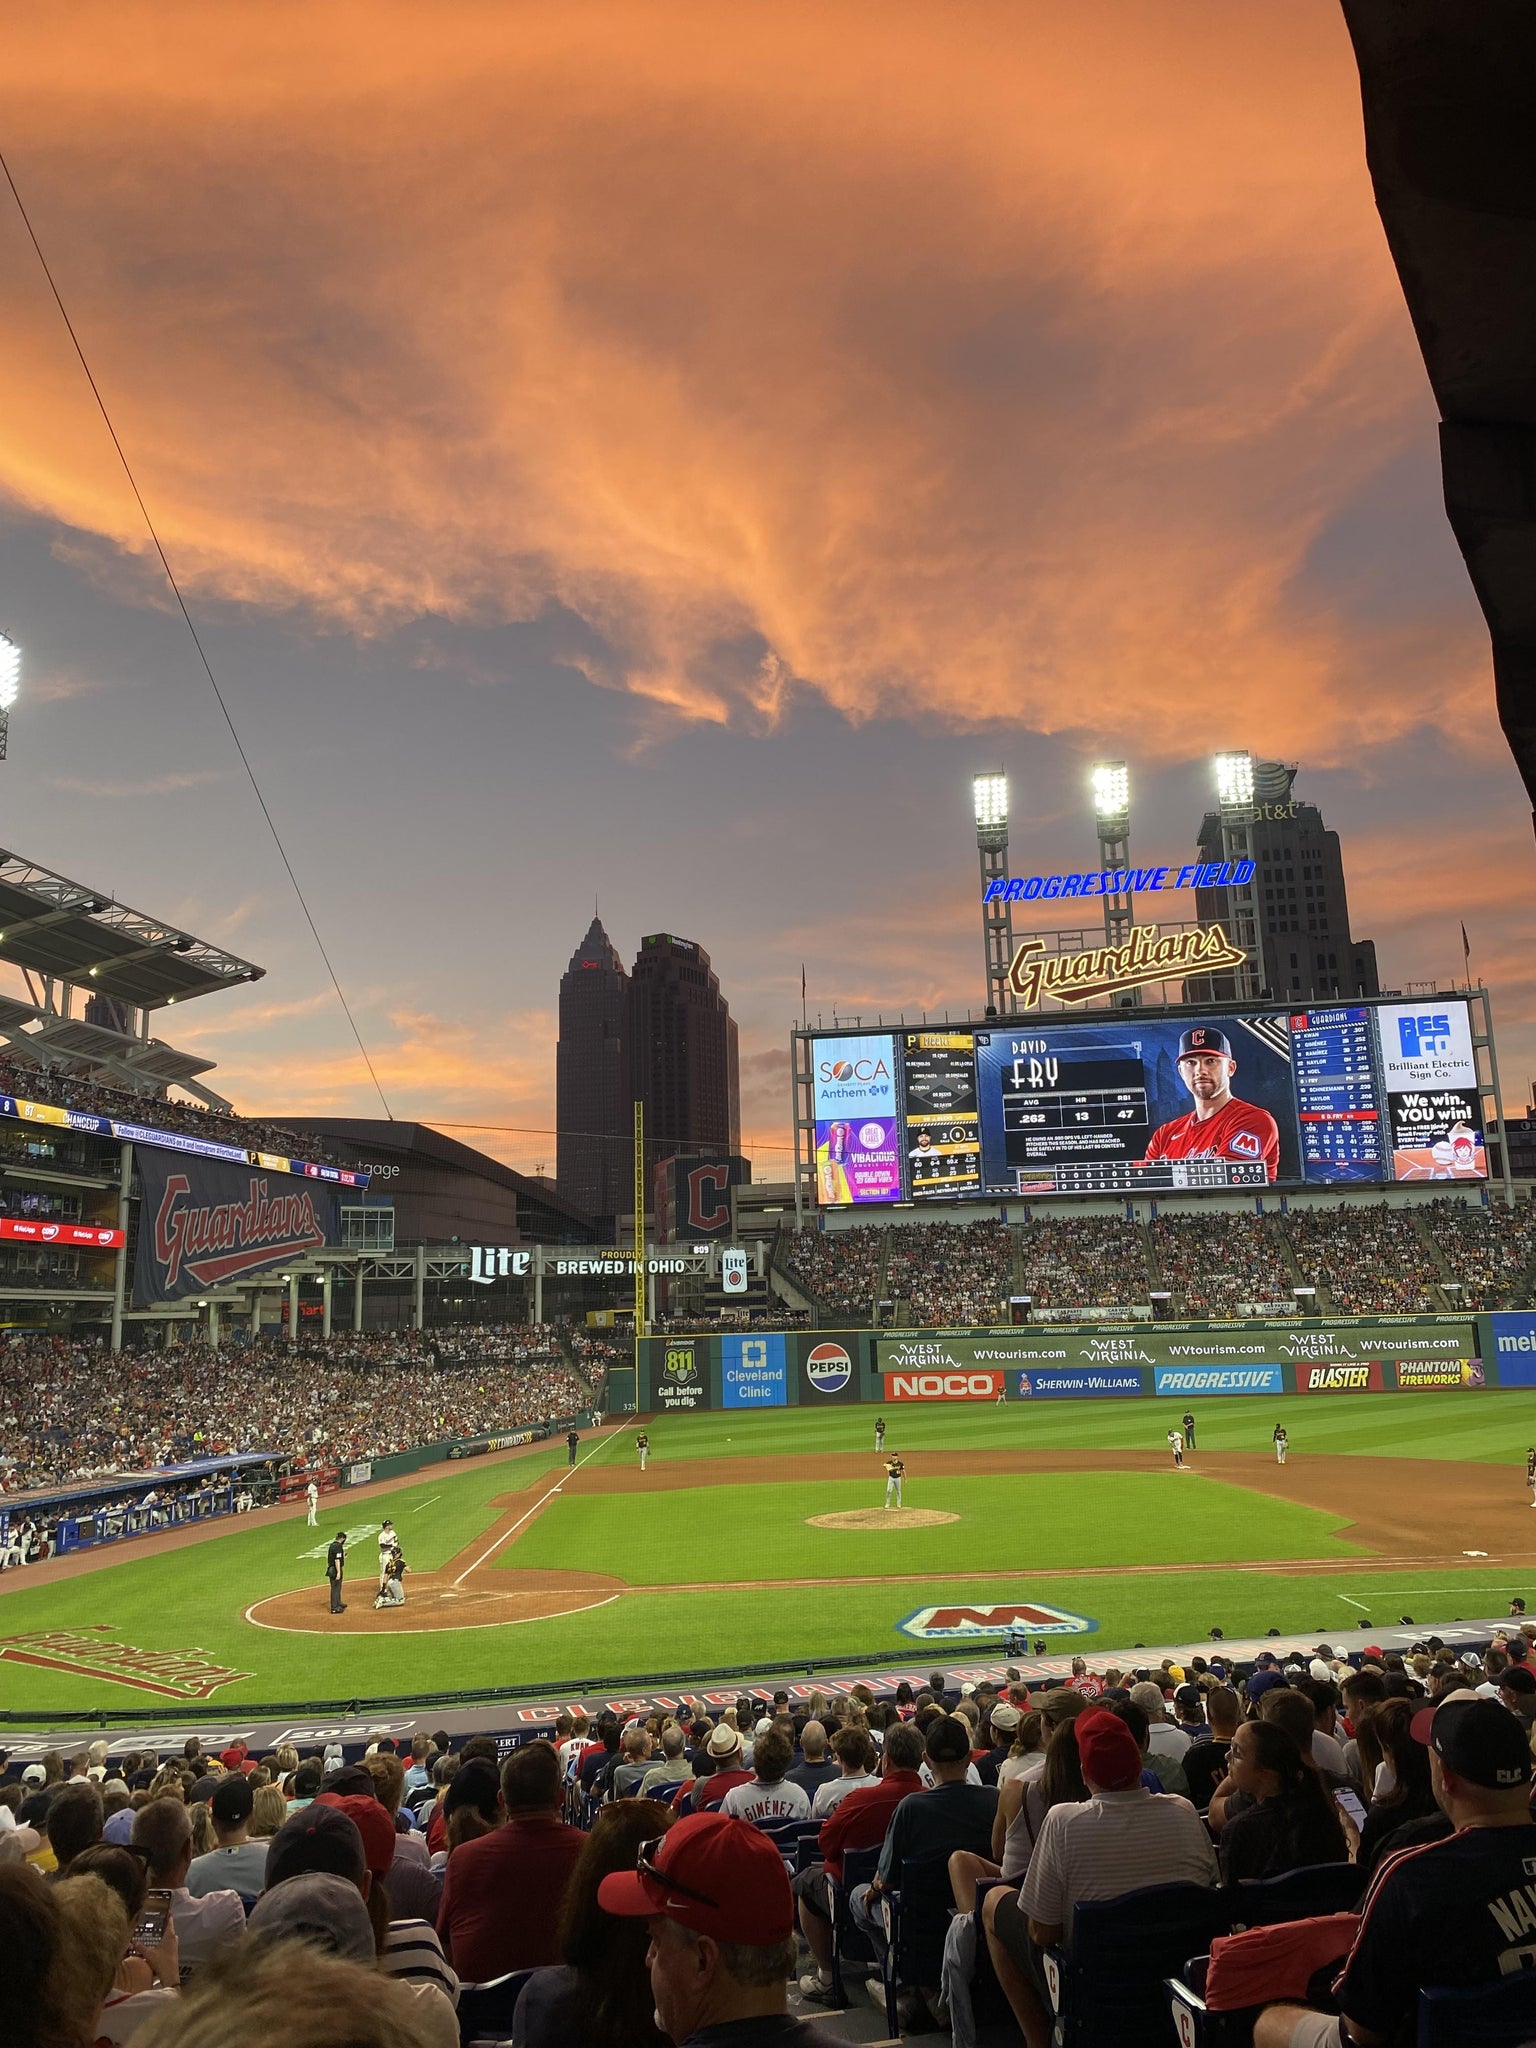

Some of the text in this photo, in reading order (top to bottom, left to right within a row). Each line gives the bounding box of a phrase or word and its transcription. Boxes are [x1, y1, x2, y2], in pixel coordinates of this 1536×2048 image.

[1254, 800, 1297, 822] at&t
[982, 860, 1256, 904] PROGRESSIVE FIELD
[1008, 923, 1247, 1011] Guardians
[1311, 1012, 1347, 1024] GUARDIANS
[907, 1035, 917, 1047] P
[1011, 1039, 1047, 1055] DAVID
[1388, 1060, 1470, 1071] Brilliant Electric
[1010, 1057, 1059, 1089] FRY
[1409, 1069, 1451, 1080] Sign Co.
[821, 1086, 867, 1099] Anthem
[1402, 1092, 1466, 1107] We win.
[4, 1100, 10, 1111] 8
[1019, 1109, 1135, 1124] .262 13 47
[1397, 1105, 1472, 1122] YOU win!
[62, 1113, 99, 1131] CHANGEUP
[250, 1152, 256, 1164] P
[851, 1151, 895, 1164] VIBACIOUS
[1238, 1166, 1244, 1174] 3
[1255, 1165, 1262, 1173] 2
[688, 1164, 730, 1231] C
[155, 1174, 326, 1290] Guardians
[600, 1250, 643, 1260] PROUDLY
[468, 1246, 531, 1285] Lite
[556, 1260, 686, 1275] BREWED IN OHIO
[724, 1256, 745, 1270] Lite
[1090, 1339, 1135, 1350] WEST
[1289, 1333, 1336, 1344] WEST
[1360, 1337, 1459, 1350] WVtourism.com
[899, 1343, 942, 1354] WEST
[973, 1349, 1066, 1360] WVtourism.com
[1168, 1343, 1265, 1355] WVtourism.com
[1278, 1344, 1357, 1359] VIRGINIA
[666, 1350, 693, 1371] 811
[888, 1354, 962, 1368] VIRGINIA
[1080, 1350, 1156, 1364] VIRGINIA
[810, 1361, 849, 1373] PEPSI
[1399, 1360, 1461, 1374] PHANTOM
[727, 1369, 783, 1382] Cleveland
[1159, 1370, 1274, 1390] PROGRESSIVE
[1308, 1366, 1370, 1389] BLASTER
[1399, 1373, 1460, 1386] FIREWORKS
[658, 1385, 703, 1396] Call before
[739, 1386, 771, 1398] Clinic
[893, 1374, 993, 1397] NOCO
[623, 1403, 636, 1411] 325
[665, 1396, 697, 1408] you dig.
[924, 1624, 1079, 1637] Marathon
[0, 1625, 257, 1700] Guardians
[291, 1722, 392, 1738] 2022
[744, 1797, 794, 1821] GIMÉNEZ
